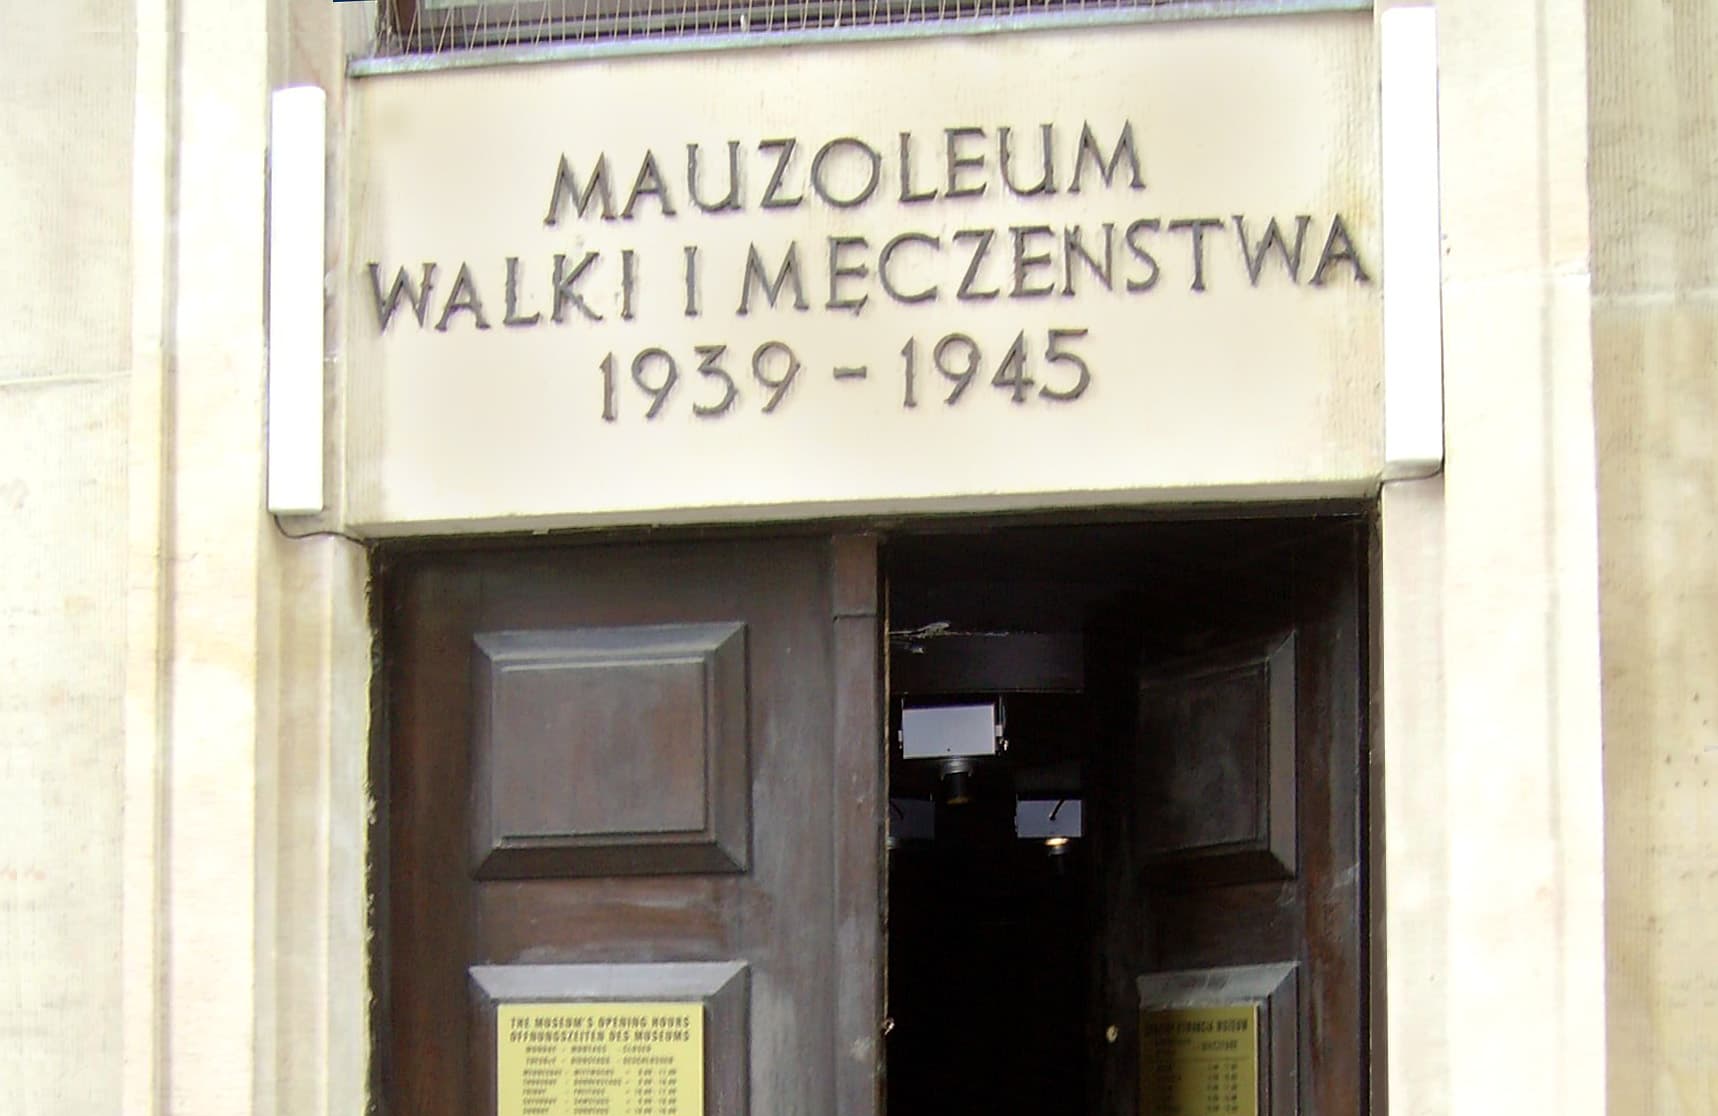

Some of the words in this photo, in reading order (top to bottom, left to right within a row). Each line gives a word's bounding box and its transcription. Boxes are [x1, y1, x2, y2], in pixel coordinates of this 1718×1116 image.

[543, 119, 1147, 227] MAUZOLEUM
[365, 249, 635, 333] WALKI
[683, 246, 699, 318] I
[599, 341, 801, 424] 1939
[900, 329, 1092, 409] 1945
[511, 1016, 529, 1029] THE
[535, 1016, 593, 1028] MUSEUM'S
[598, 1016, 647, 1028] OPENING
[652, 1016, 690, 1028] HOURS
[609, 1031, 629, 1042] DES
[634, 1031, 690, 1042] MUSEUMS
